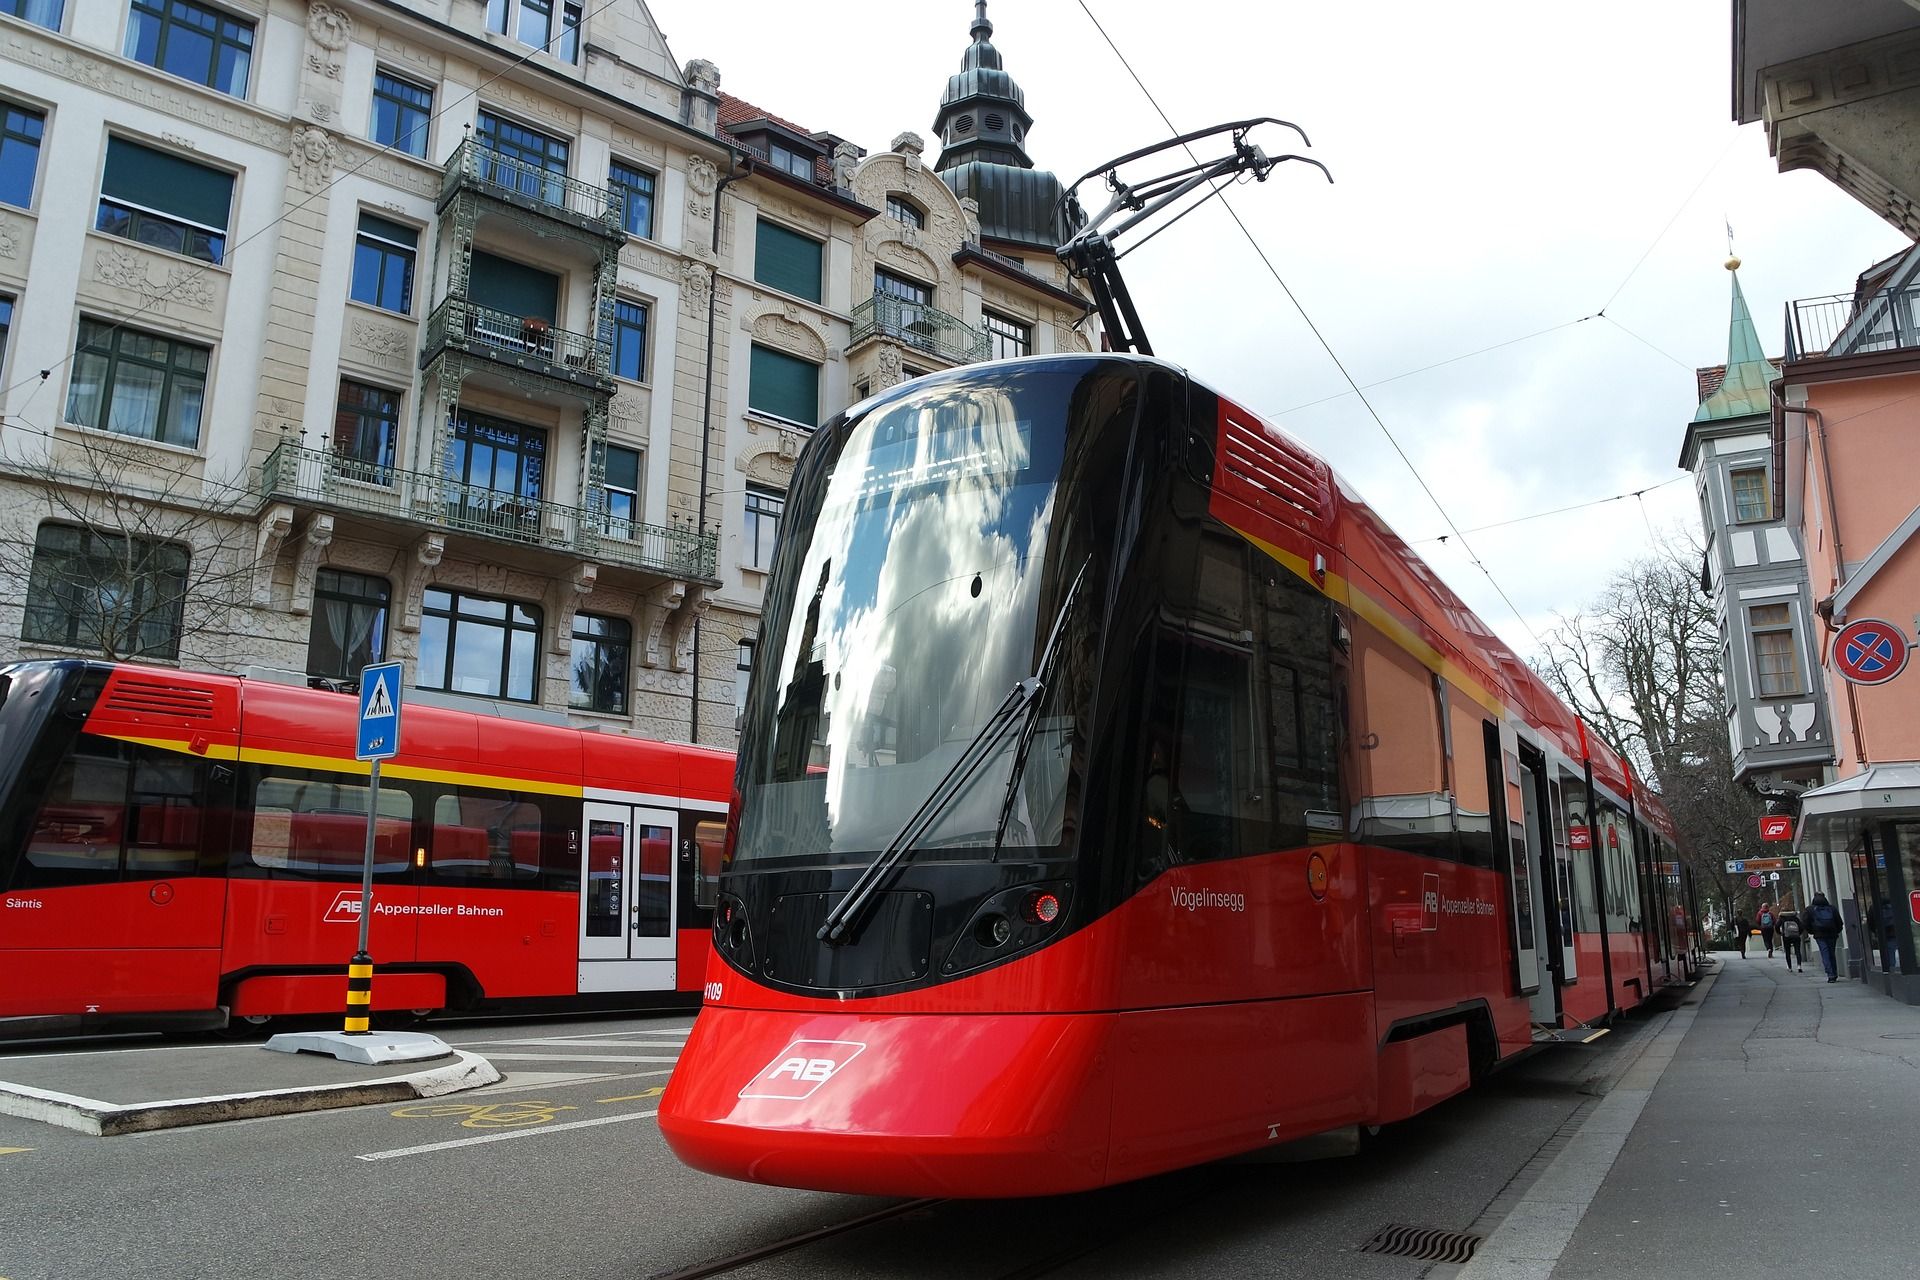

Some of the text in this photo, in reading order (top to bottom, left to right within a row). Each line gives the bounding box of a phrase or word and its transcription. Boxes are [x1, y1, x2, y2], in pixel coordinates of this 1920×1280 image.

[571, 831, 575, 840] 1
[683, 841, 689, 849] 2
[5, 897, 43, 909] Säntis
[1170, 885, 1245, 912] Vögelinsegg
[1424, 891, 1496, 917] AB Appenzeller Bahnen
[335, 900, 504, 916] AB Appenzeller Bahnen
[766, 1057, 836, 1082] AB
